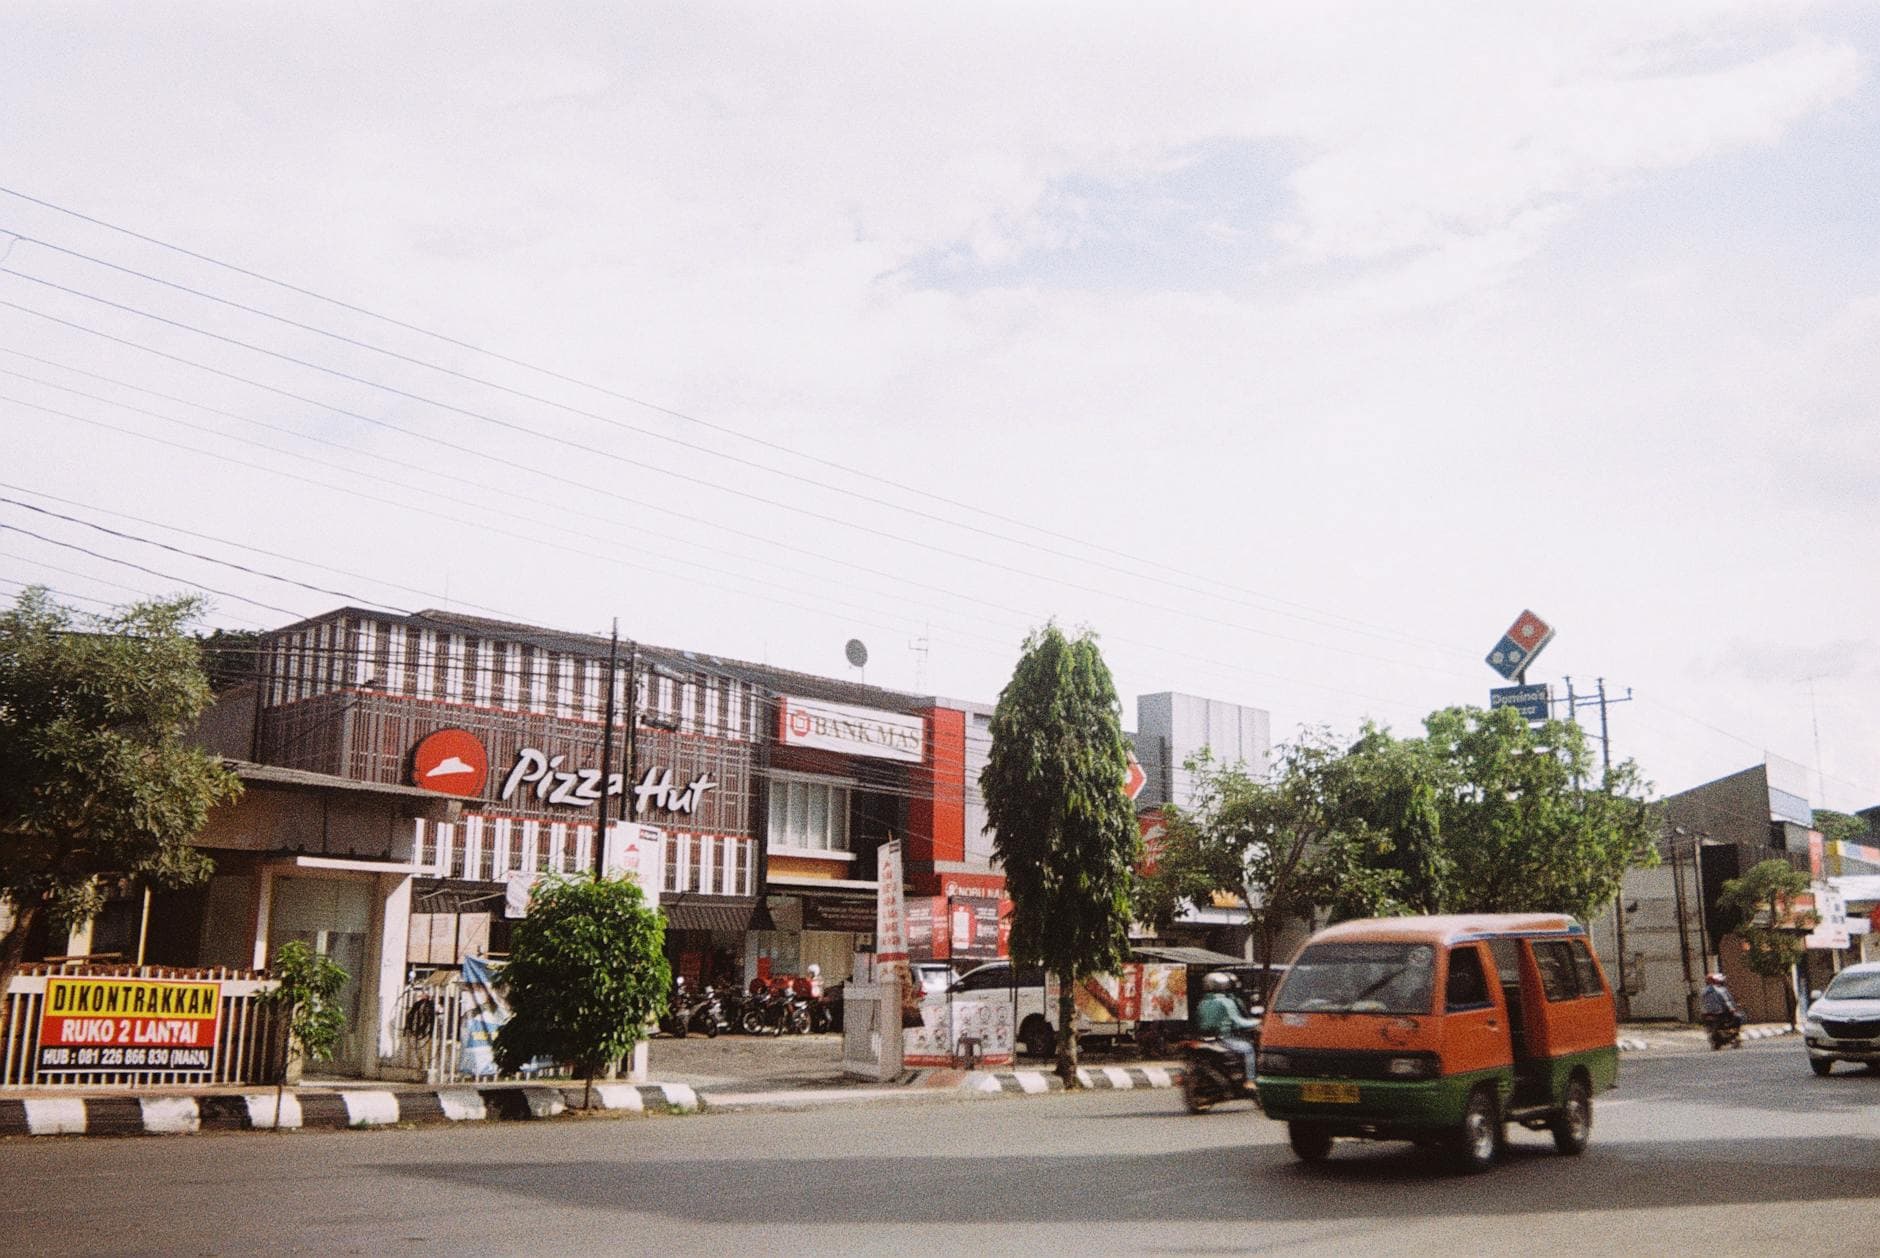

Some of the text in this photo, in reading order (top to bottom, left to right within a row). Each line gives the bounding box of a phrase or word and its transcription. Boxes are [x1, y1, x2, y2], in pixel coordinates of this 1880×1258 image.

[815, 717, 920, 749] BANK MAS
[502, 748, 718, 813] Pizza Hut
[53, 985, 214, 1014] DIKONTRAKKAN
[61, 1019, 198, 1044] RUKO 2 LANTAI
[42, 1048, 69, 1065] HUB
[101, 1048, 123, 1065] 226
